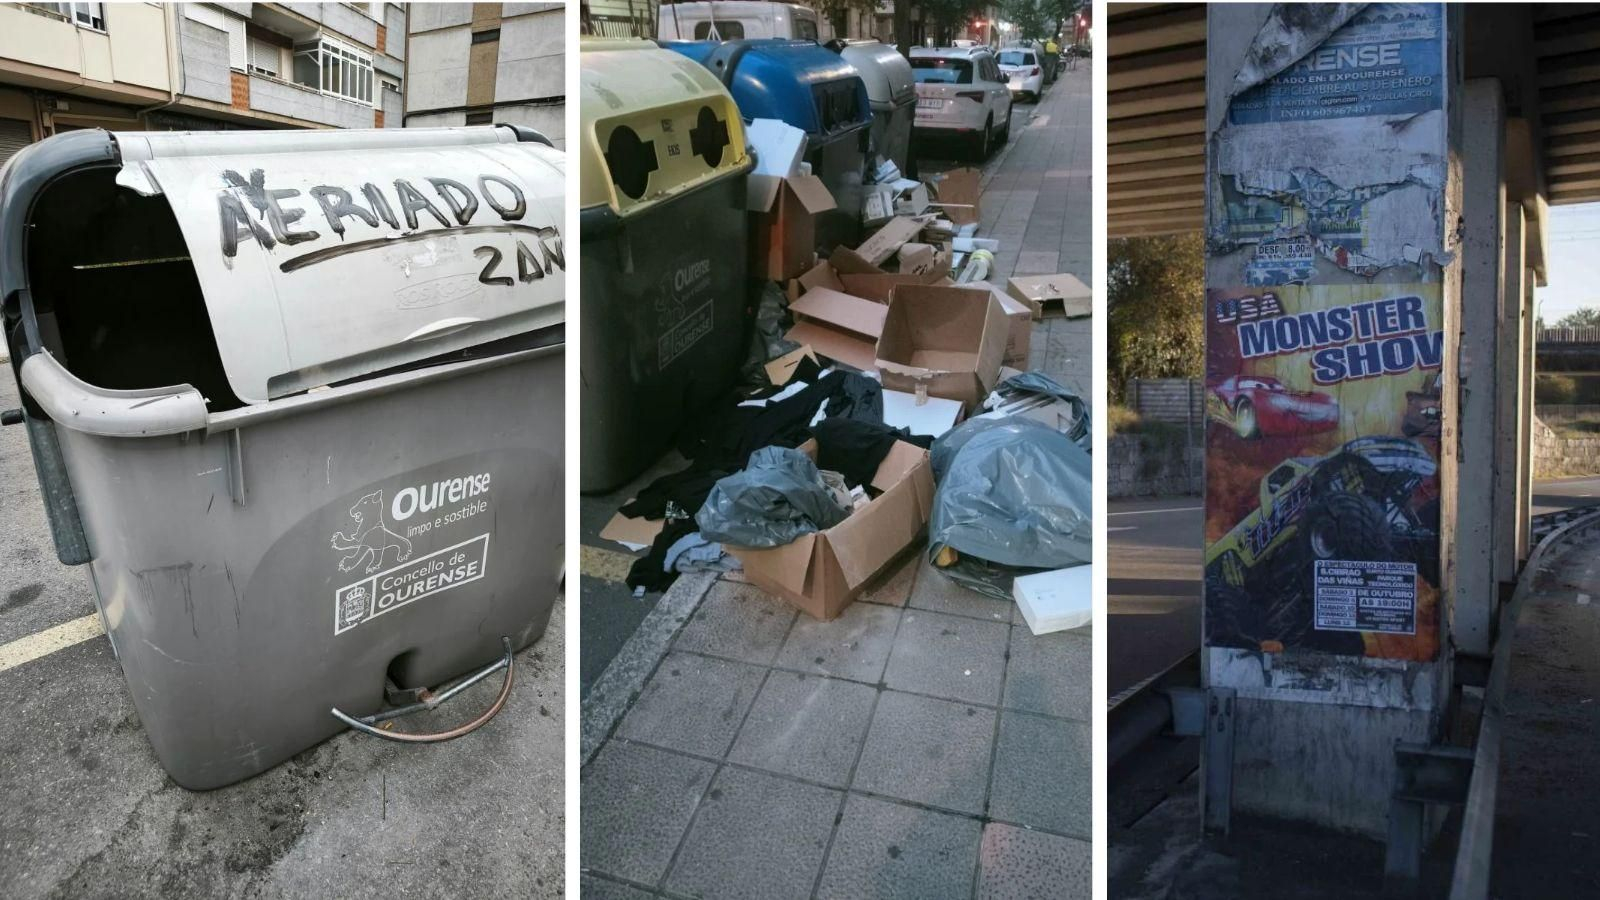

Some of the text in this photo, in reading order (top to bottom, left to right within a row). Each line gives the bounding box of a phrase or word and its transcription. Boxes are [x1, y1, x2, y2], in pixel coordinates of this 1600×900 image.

[1329, 68, 1405, 82] EXPOURENSE
[1391, 75, 1432, 89] ENERO
[675, 258, 711, 291] Ourense
[1215, 292, 1281, 323] USA
[1237, 295, 1427, 359] MONSTER
[391, 472, 491, 522] Ourense
[407, 499, 488, 539] limpo e sostible
[378, 561, 478, 609] OURENSE
[381, 552, 465, 591] Concello de
[1371, 590, 1413, 598] OUTUBRO
